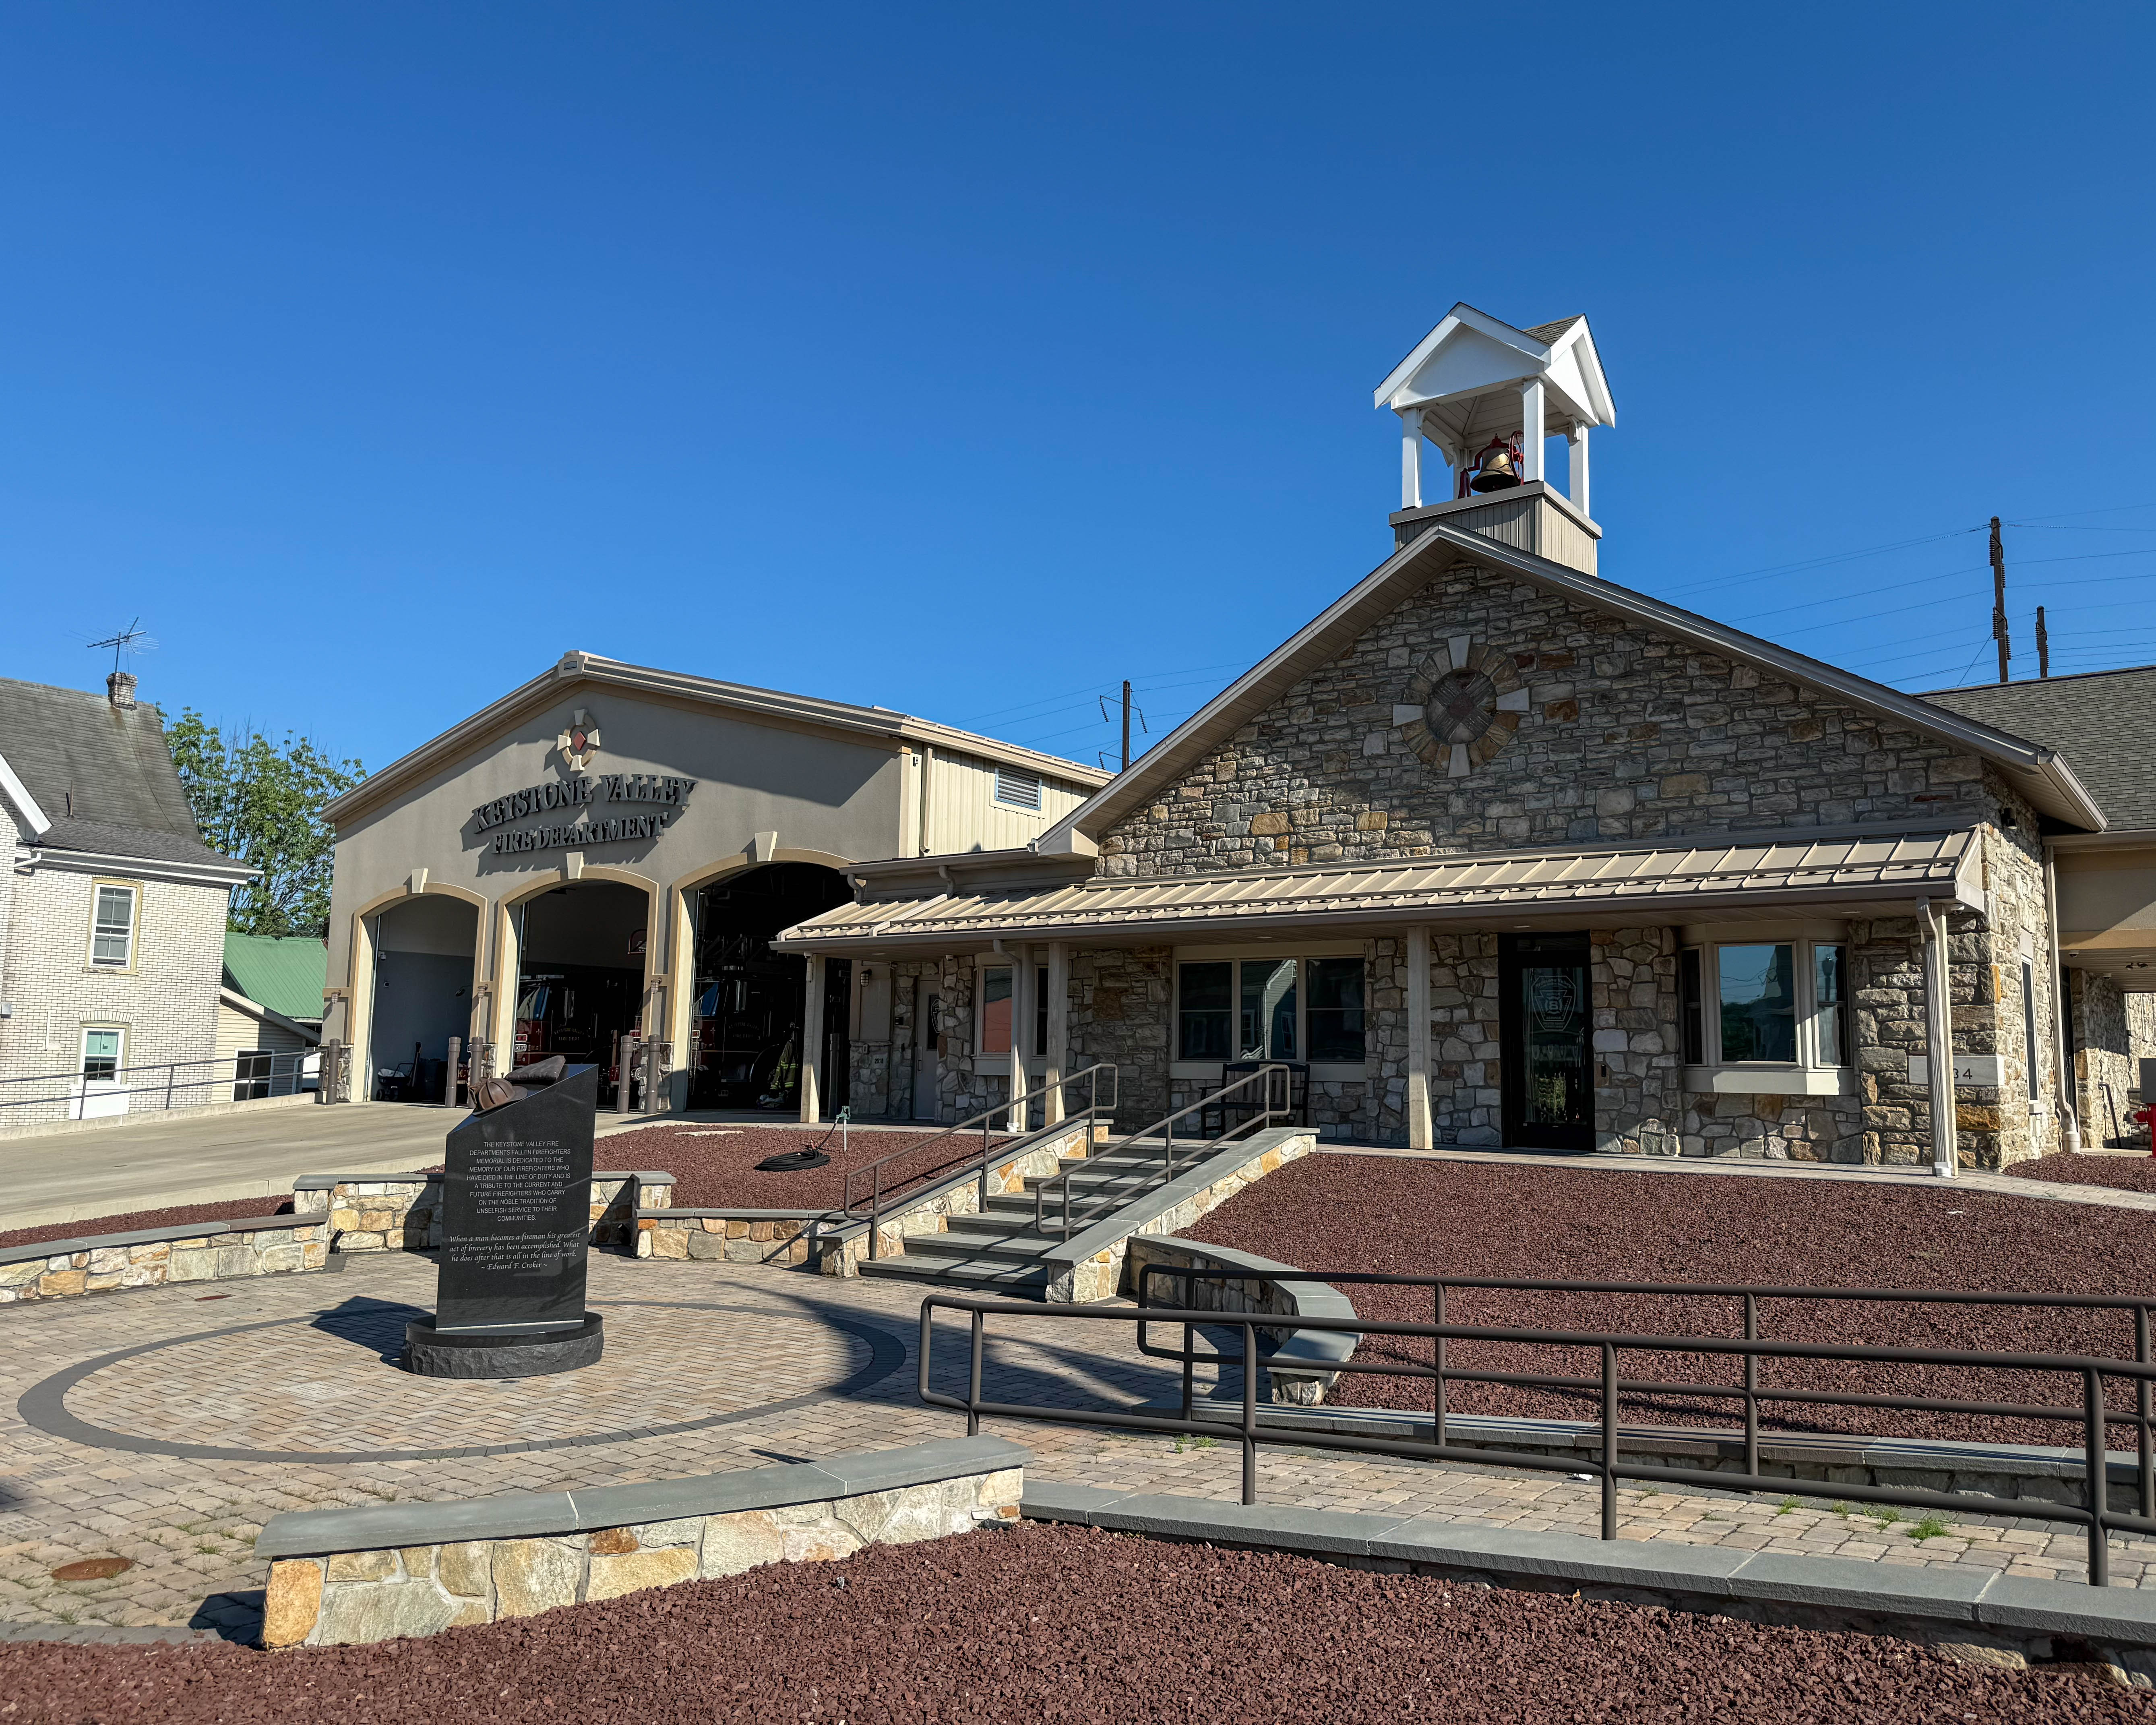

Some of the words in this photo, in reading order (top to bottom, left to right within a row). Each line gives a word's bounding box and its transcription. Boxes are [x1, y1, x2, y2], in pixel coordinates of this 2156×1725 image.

[472, 776, 593, 834] KEYSTONE
[599, 774, 698, 807] VALLEY
[493, 829, 535, 854] FIRE
[534, 812, 668, 850] DEPARTMENT
[1549, 1001, 1558, 1010] 8
[521, 1232, 545, 1241] fireman
[557, 1232, 581, 1240] greatest
[461, 1244, 468, 1252] of
[469, 1244, 492, 1252] bravery
[521, 1241, 561, 1250] accomplished.
[460, 1253, 473, 1261] does
[474, 1252, 490, 1263] after
[554, 1250, 560, 1259] of
